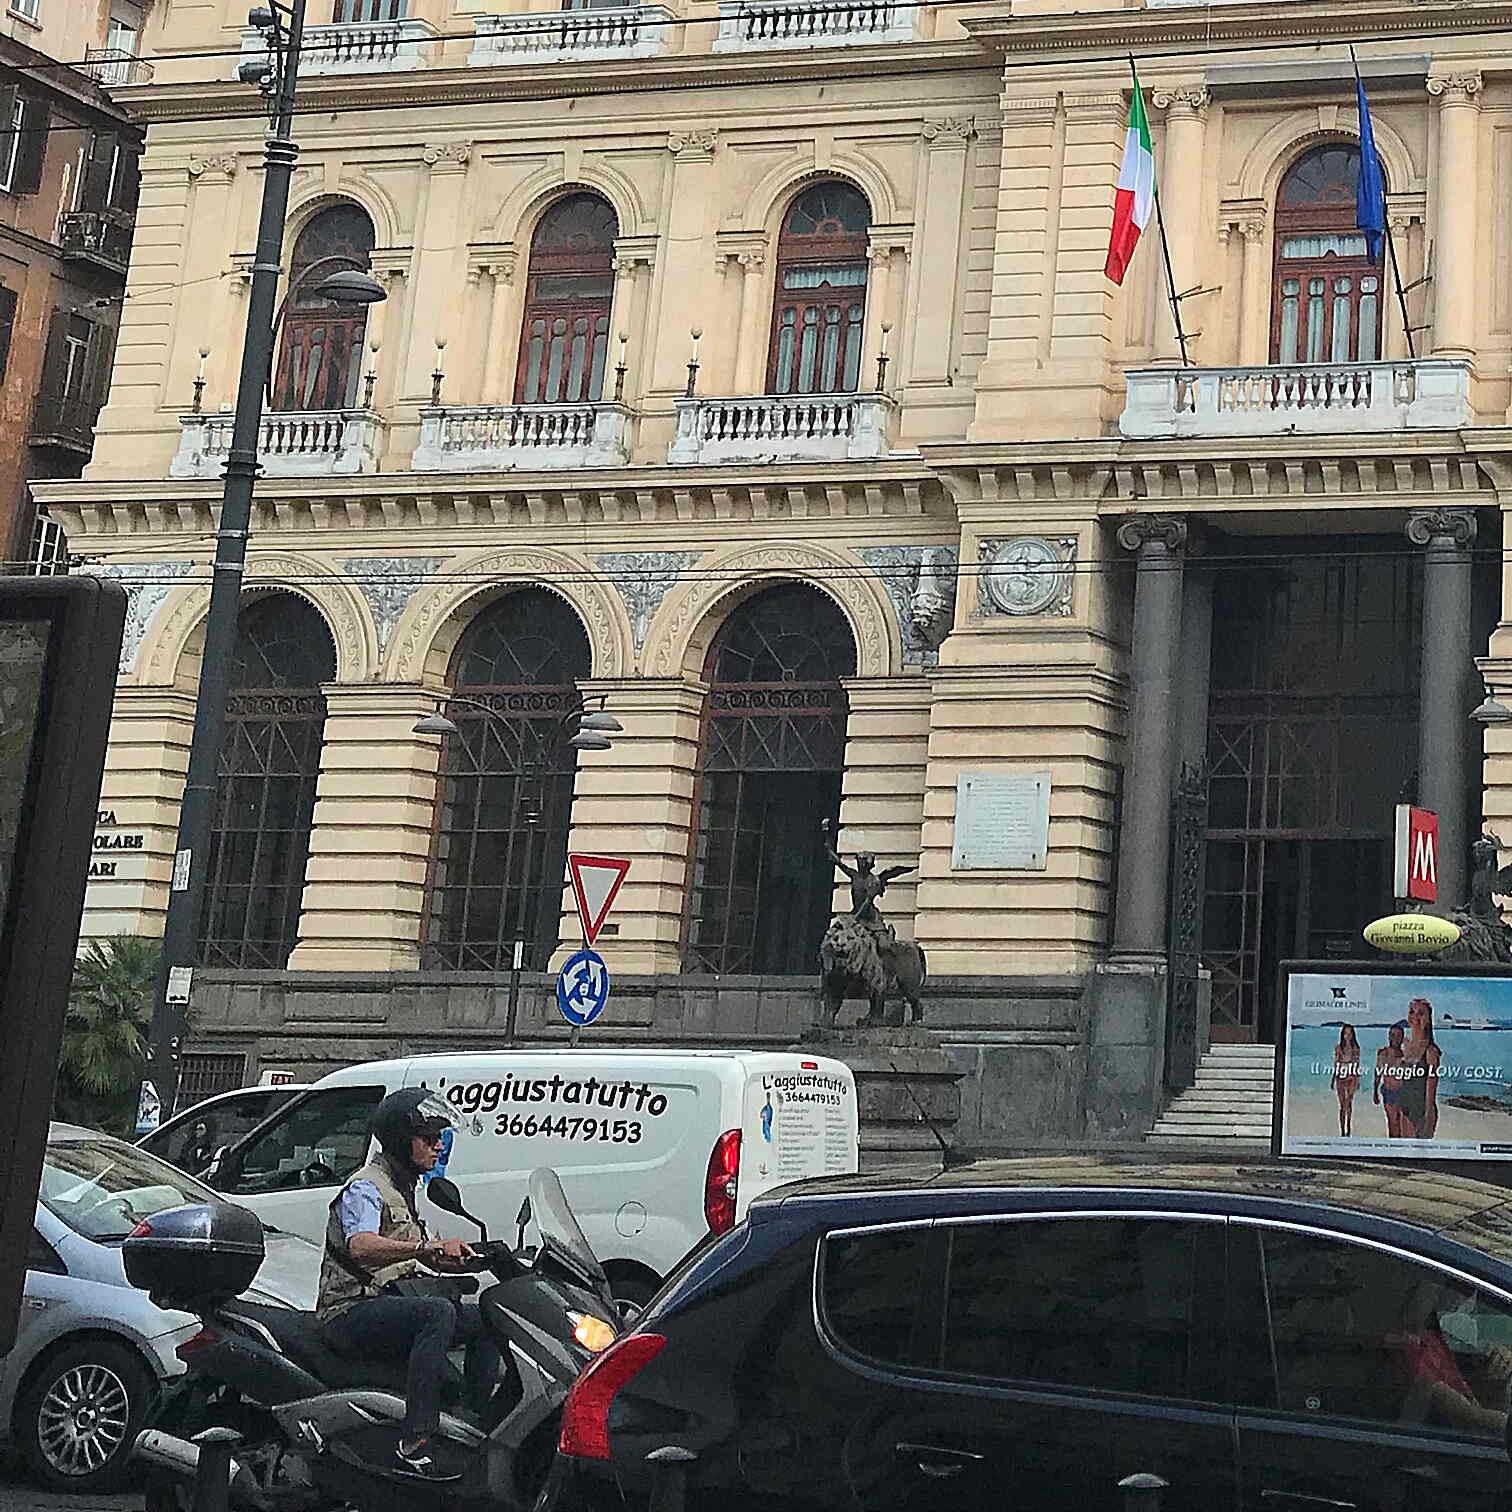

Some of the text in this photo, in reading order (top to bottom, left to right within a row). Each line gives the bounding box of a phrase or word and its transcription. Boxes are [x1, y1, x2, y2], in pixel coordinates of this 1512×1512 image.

[98, 811, 117, 824] CA
[94, 835, 144, 848] OLARE
[1413, 830, 1436, 883] M
[88, 863, 117, 876] ARI
[1393, 921, 1424, 932] piazza
[1418, 933, 1449, 944] Bovio
[1376, 1064, 1425, 1079] viaggio
[1428, 1064, 1460, 1077] LOW
[762, 1074, 847, 1095] L'aggiustatutto
[421, 1073, 668, 1116] 'aggiustatutto
[785, 1093, 841, 1105] 3664479153
[494, 1114, 642, 1144] 3664479153
